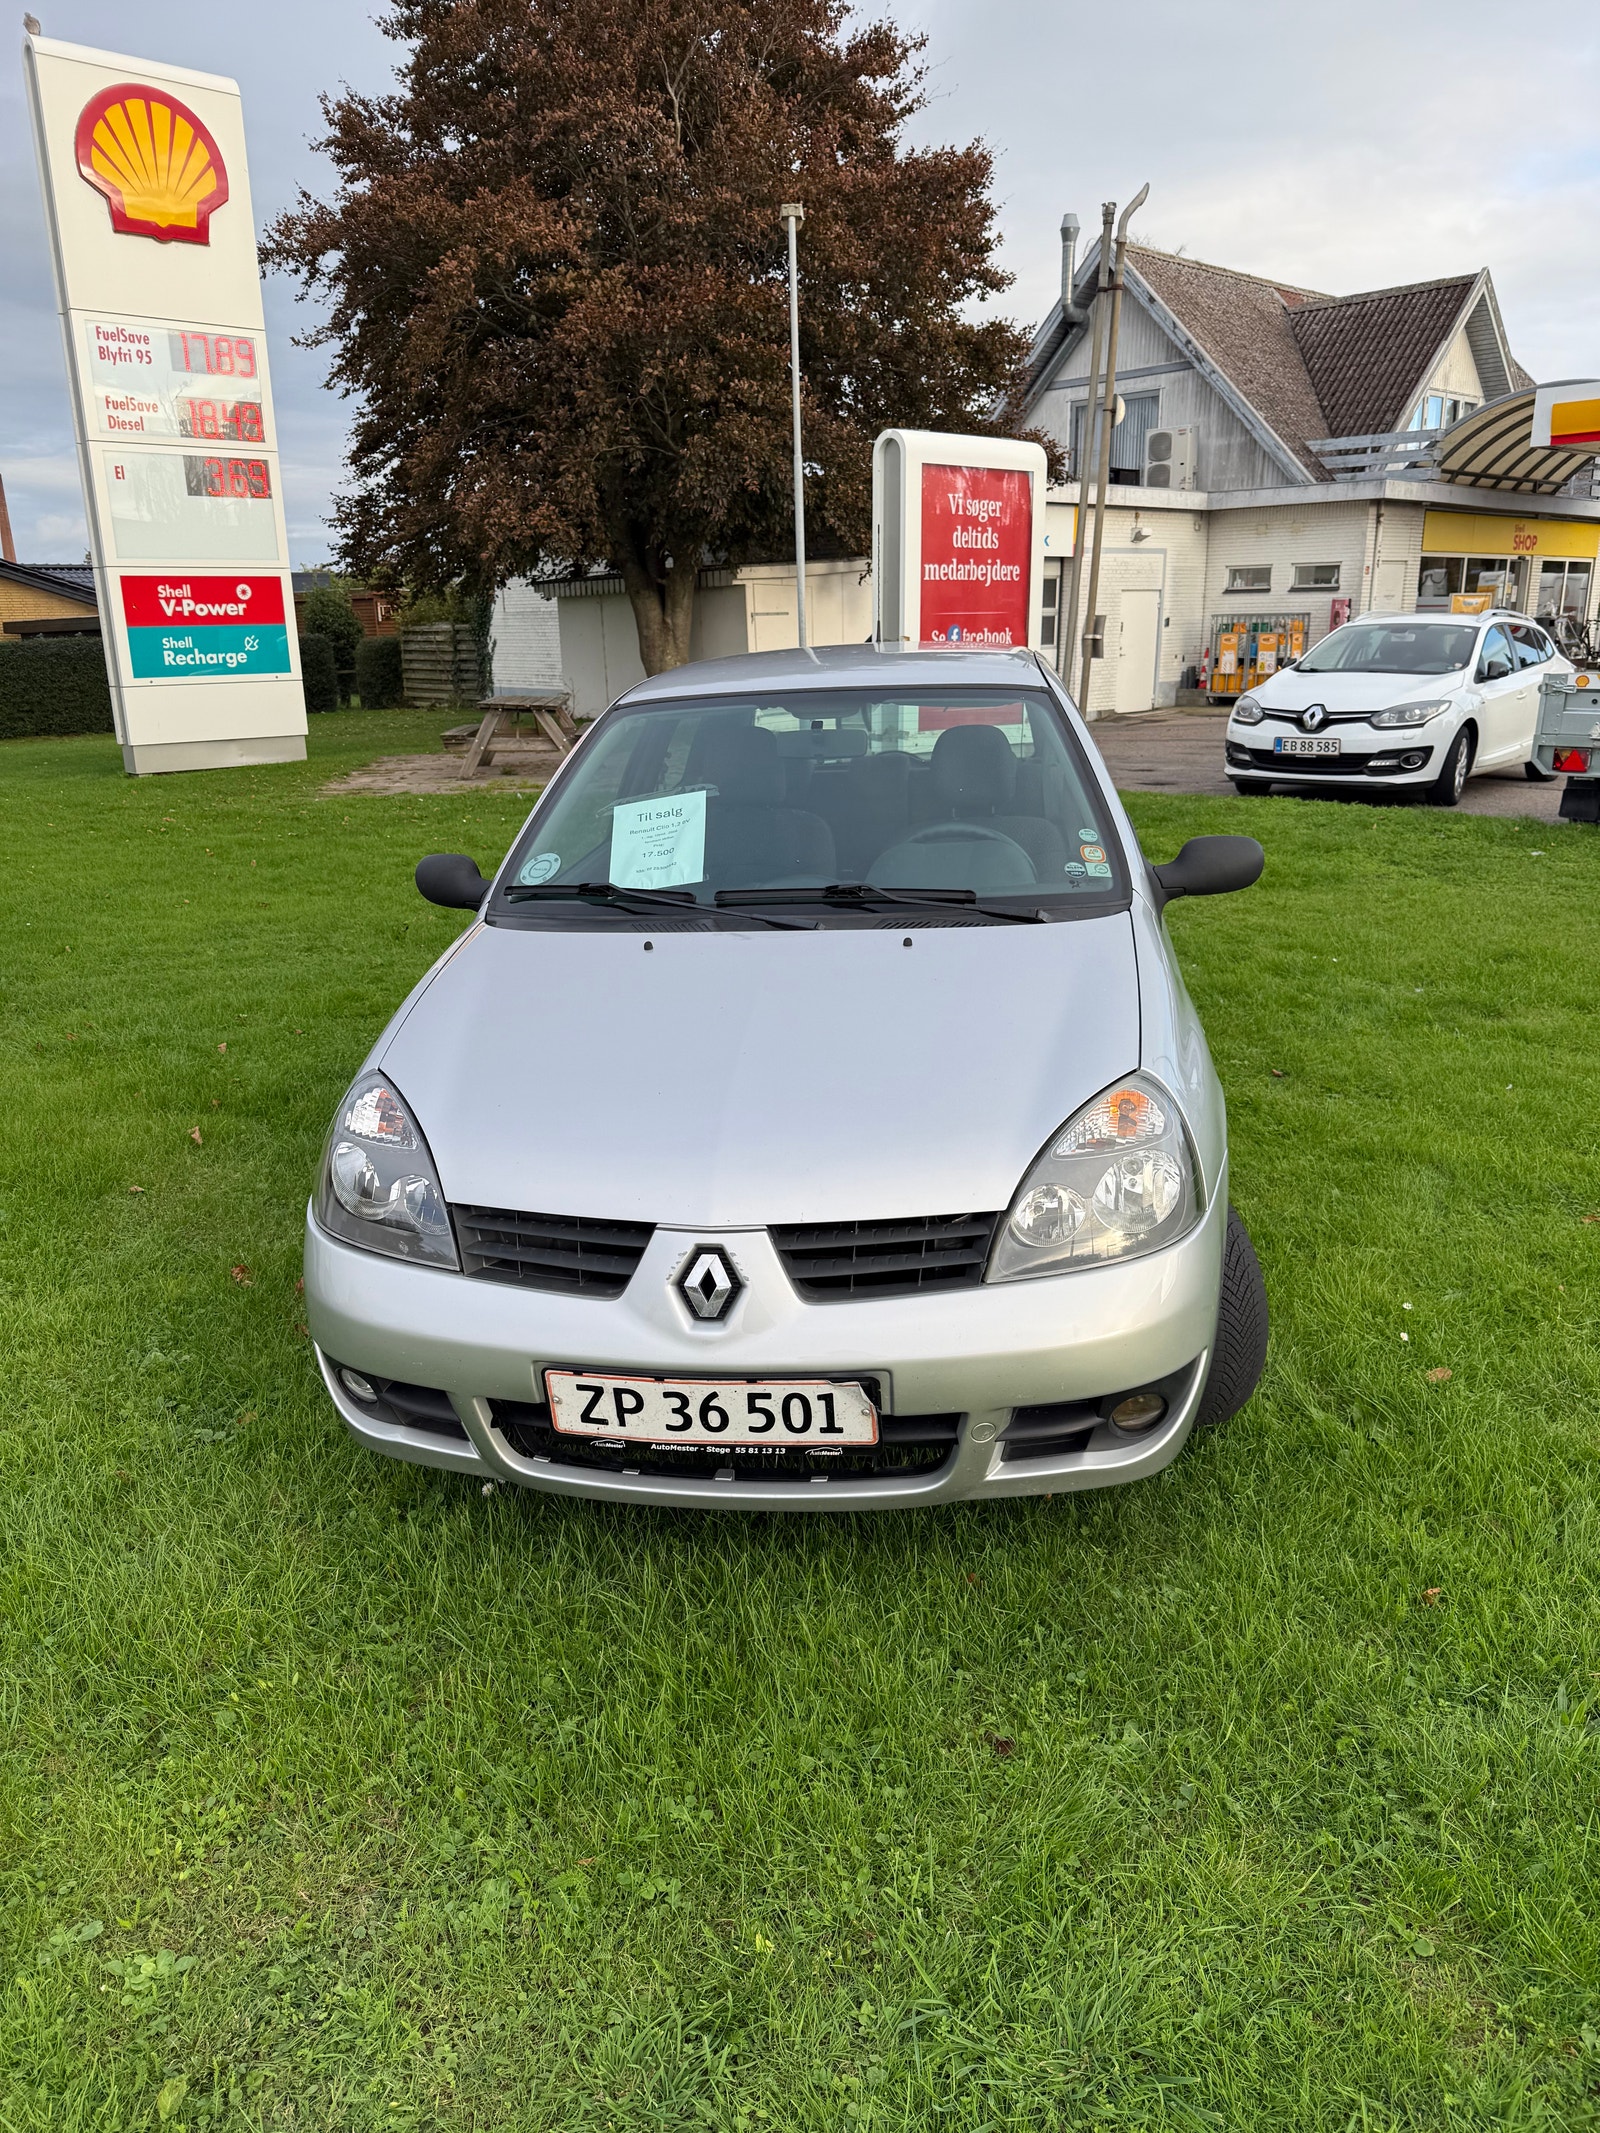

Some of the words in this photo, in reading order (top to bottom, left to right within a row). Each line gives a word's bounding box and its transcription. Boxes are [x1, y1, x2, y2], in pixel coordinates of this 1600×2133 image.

[95, 325, 150, 345] FuelSave
[98, 345, 132, 366] Blyfri
[136, 350, 152, 365] 95
[105, 395, 159, 413] FuelSave
[107, 415, 145, 431] Diesel
[114, 465, 125, 480] El
[948, 493, 964, 515] Vi
[966, 498, 1002, 523] søger
[952, 525, 999, 549] deltids
[1513, 534, 1538, 551] SHOP
[923, 558, 1020, 587] medarbejdere
[157, 584, 191, 598] Shell
[159, 598, 247, 617] V-Power
[162, 636, 193, 649] Shell
[163, 649, 247, 668] Recharge
[1283, 740, 1297, 751] EB
[1300, 741, 1314, 752] 88
[1316, 741, 1337, 753] 585
[637, 813, 653, 822] Til
[655, 808, 683, 820] salg
[629, 826, 655, 835] Renault
[656, 824, 670, 832] Clio
[642, 847, 675, 858] 17.500
[575, 1383, 645, 1428] ZP
[661, 1390, 730, 1433] 36
[747, 1391, 844, 1434] 501
[650, 1443, 698, 1452] AutoMester
[706, 1446, 730, 1454] Stege
